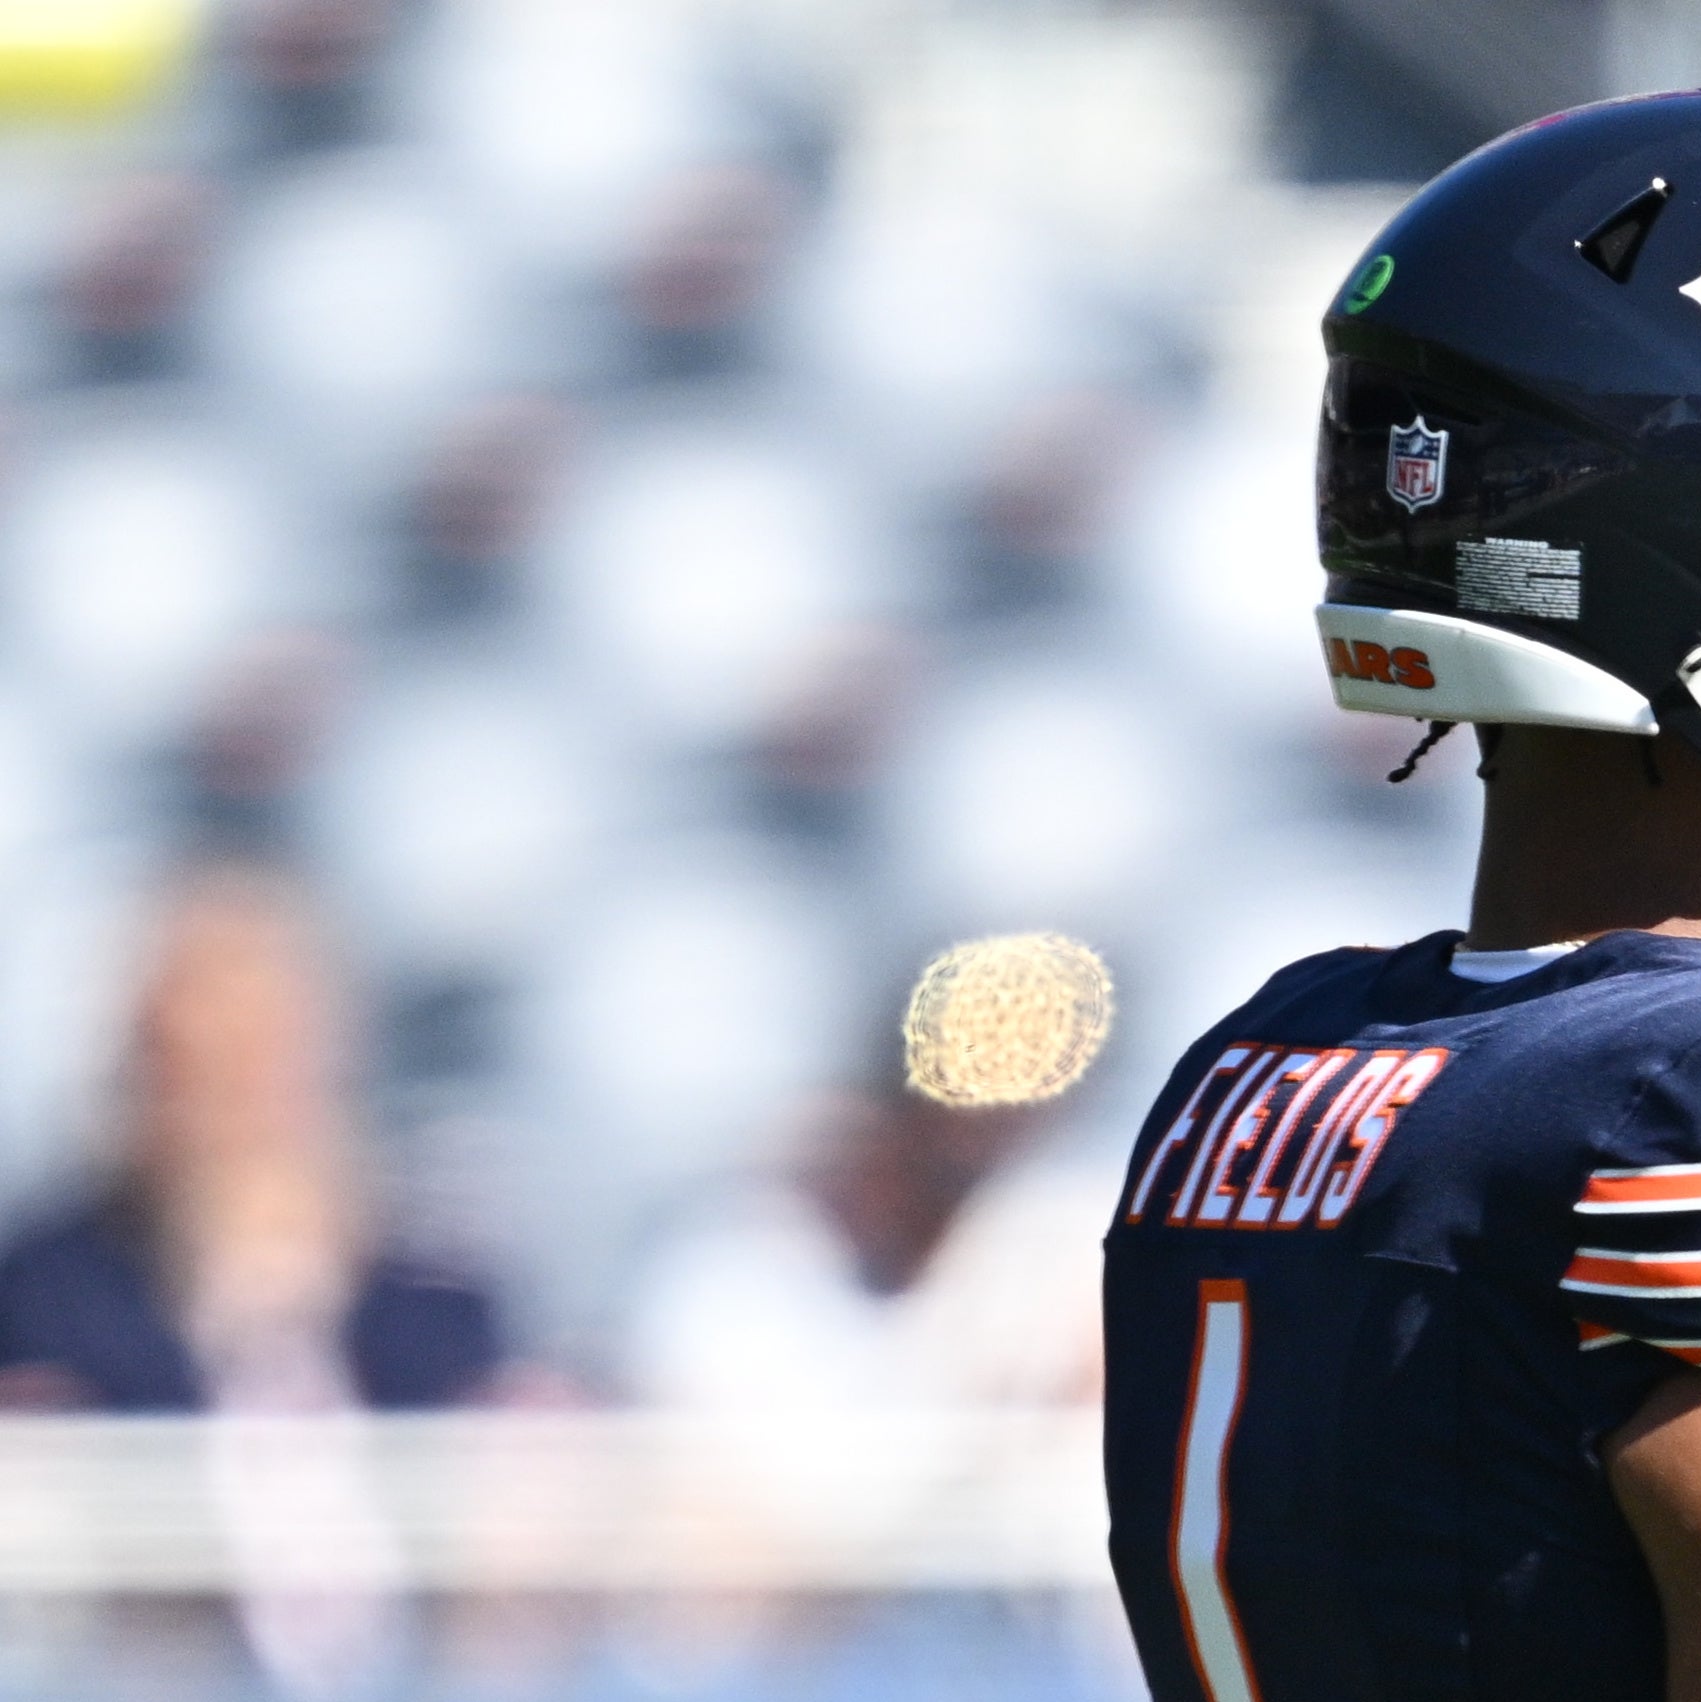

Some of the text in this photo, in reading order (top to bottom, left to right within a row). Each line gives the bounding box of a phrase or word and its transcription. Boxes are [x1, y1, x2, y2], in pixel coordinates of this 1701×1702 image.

[1394, 460, 1435, 498] NFL
[1327, 637, 1436, 690] ARS
[1125, 1041, 1448, 1231] FIELDS
